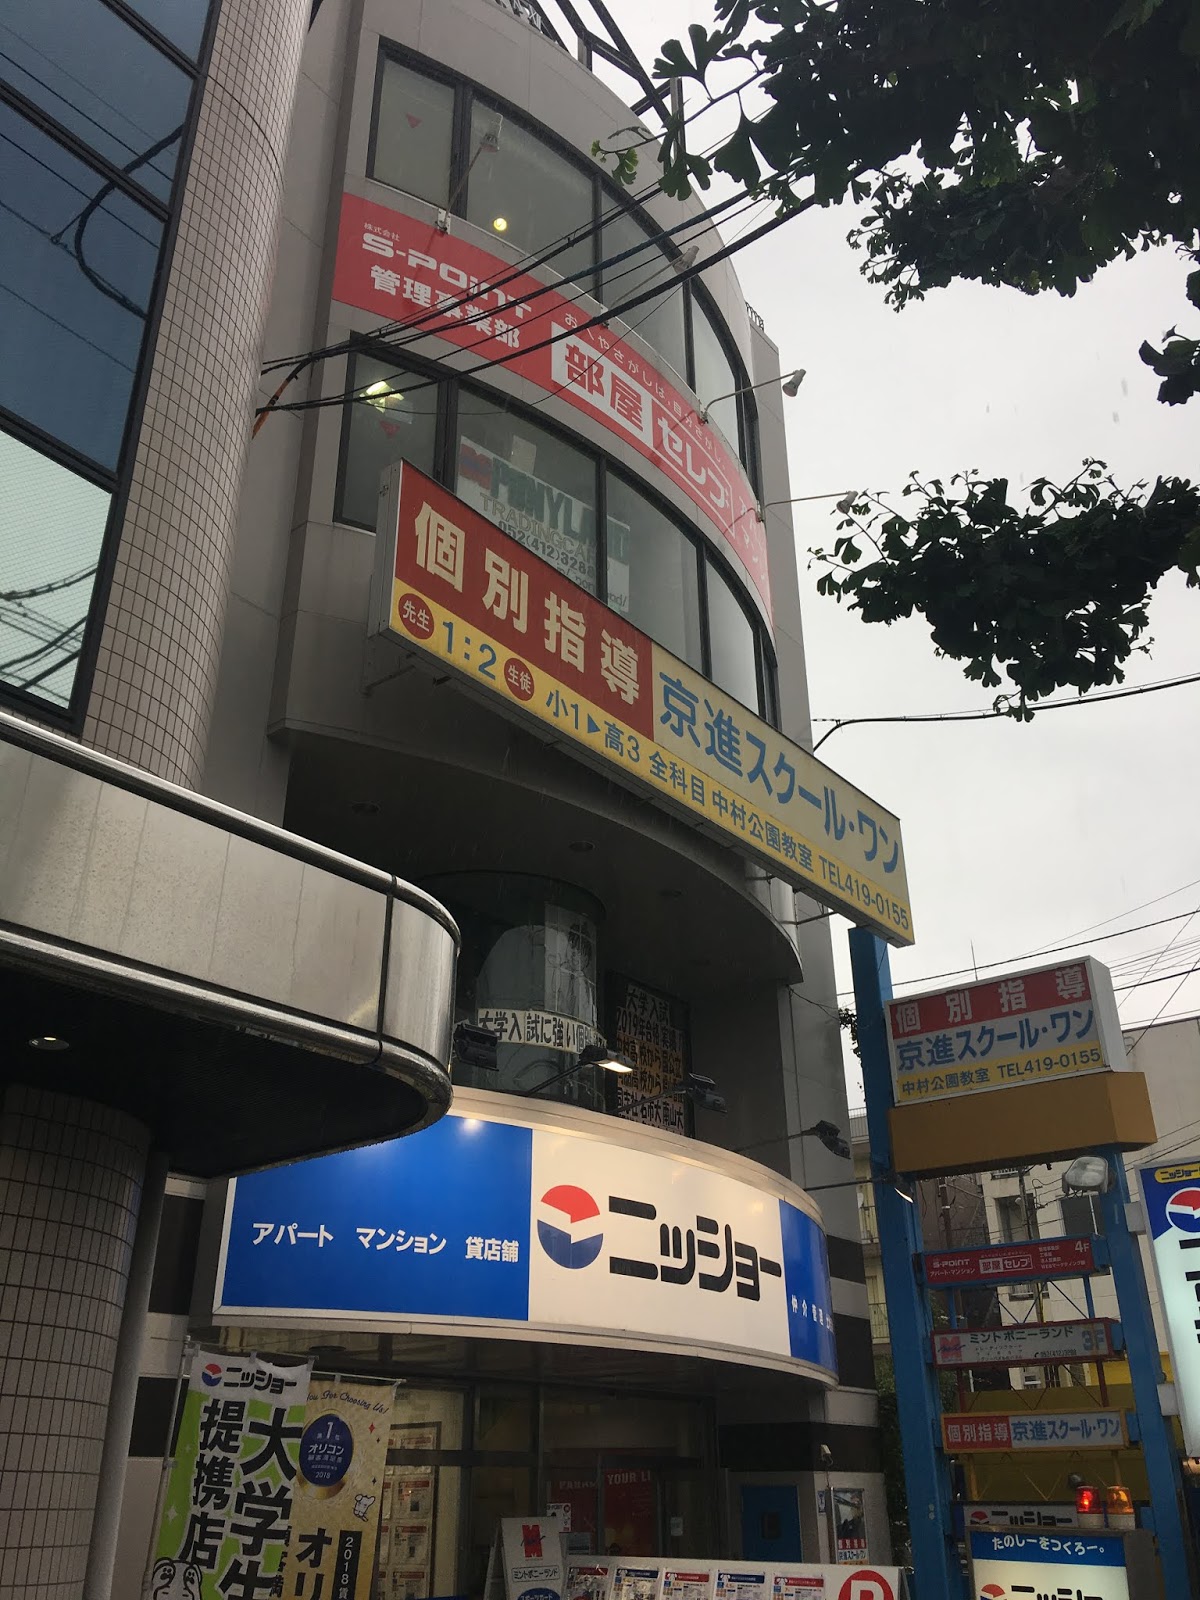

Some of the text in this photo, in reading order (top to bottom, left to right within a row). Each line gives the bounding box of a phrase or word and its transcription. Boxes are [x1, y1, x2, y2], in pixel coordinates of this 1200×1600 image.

[364, 222, 400, 242] 株式会社
[370, 264, 521, 349] 管理事業部
[414, 500, 640, 705] 個別指導
[402, 600, 431, 633] 先生
[442, 621, 498, 681] 1:2
[507, 664, 532, 695] 生徒
[649, 751, 706, 807] 全科目
[712, 790, 815, 873] 中村公園教室
[819, 855, 910, 931] TEL419-0155
[659, 671, 899, 873] 京進スクール・ワン
[896, 966, 1086, 1034] 個別指導
[896, 1009, 1094, 1072] 京進スクール・ワン
[902, 1048, 1101, 1096] 中村公園教室 TEL419-0155
[252, 1222, 520, 1263] アパート マンション 貸店舗
[609, 1195, 782, 1302] ニッショー
[1075, 1240, 1090, 1253] 4F
[224, 1367, 297, 1394] ニッショー
[340, 1392, 372, 1411] Choosing
[947, 1417, 1120, 1442] 個別指導 京進スクール・ワン
[307, 1443, 345, 1455] オリコン
[178, 1398, 246, 1569] 提携店
[315, 1471, 331, 1479] 2018
[607, 1472, 636, 1485] YOUR
[992, 1534, 1105, 1556] たのしーをつくろー。
[513, 1568, 558, 1580] ミントポニーランド
